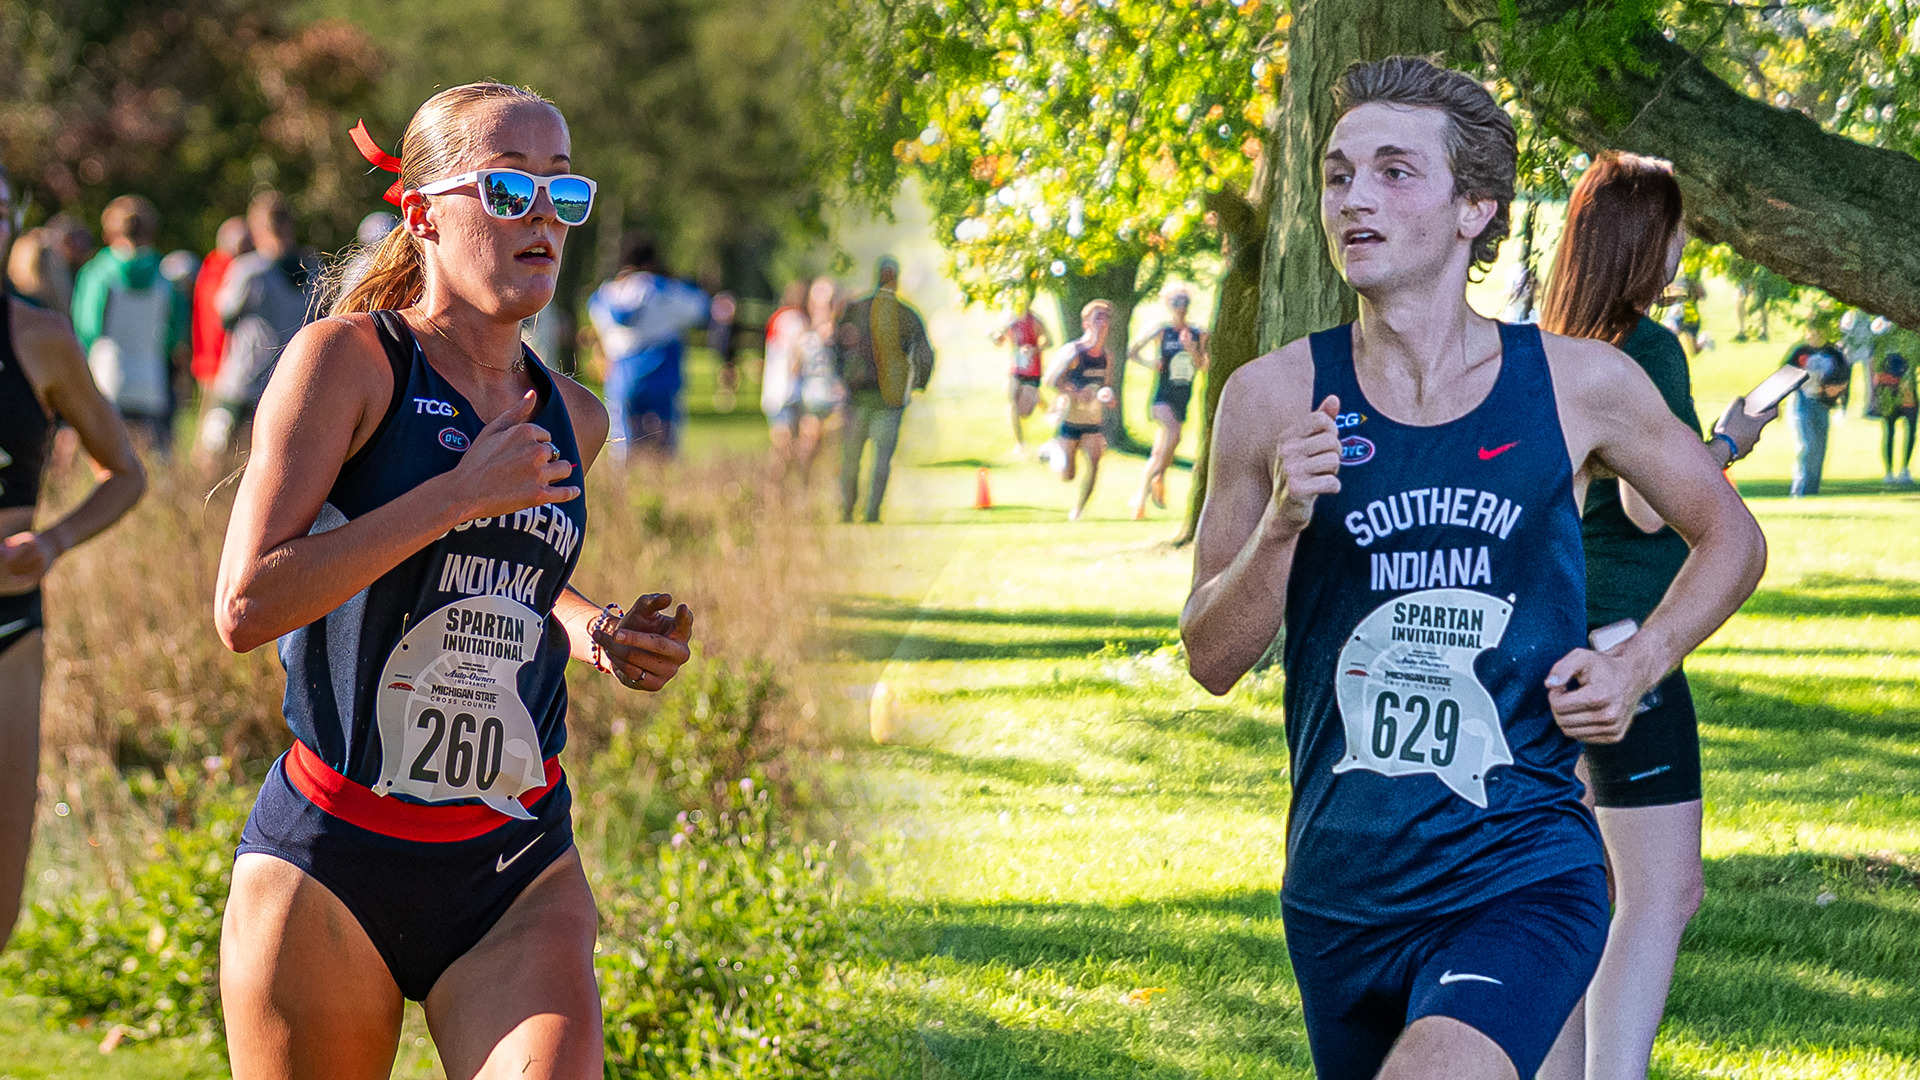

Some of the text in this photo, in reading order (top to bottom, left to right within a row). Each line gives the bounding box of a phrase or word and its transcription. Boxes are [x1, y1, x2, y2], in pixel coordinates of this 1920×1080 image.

[413, 398, 453, 416] TCG
[1335, 412, 1359, 428] CG
[445, 433, 463, 446] OVC
[1345, 487, 1523, 546] SOUTHERN
[437, 503, 579, 563] HERN
[438, 553, 544, 605] INDIANA
[1371, 546, 1492, 591] INDIANA
[445, 607, 524, 643] SPARTAN
[1393, 602, 1483, 632] SPARTAN
[442, 633, 523, 662] INVITATIONAL
[1391, 626, 1482, 649] INVITATIONAL
[445, 669, 497, 684] Auto-Owners
[454, 678, 487, 688] INSURANCE
[430, 695, 497, 711] CROSS COUNTRY
[431, 684, 474, 700] MICHIGAN
[475, 690, 499, 704] STATE
[1372, 691, 1460, 767] 629
[409, 708, 504, 791] 260
